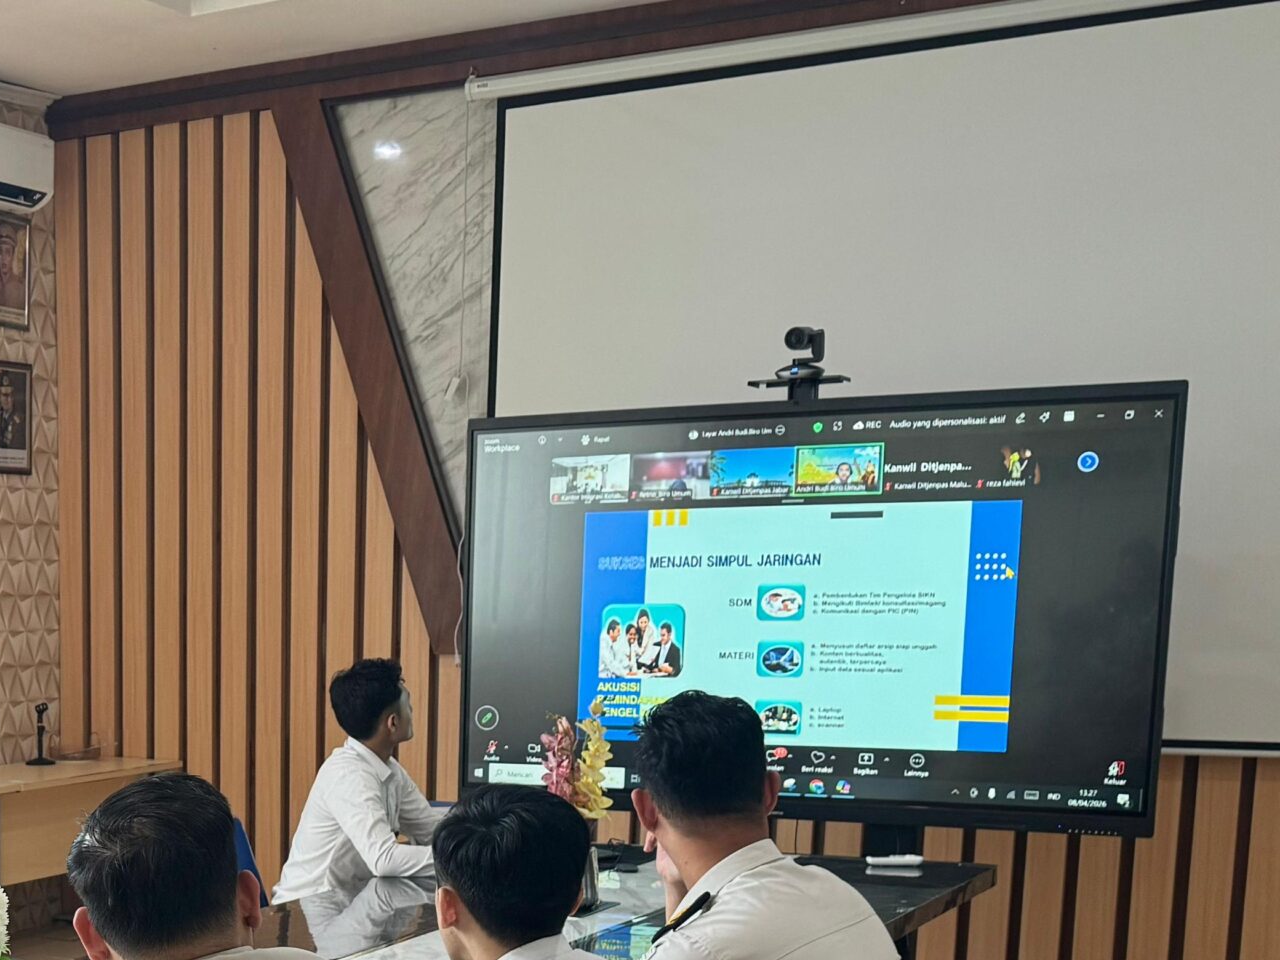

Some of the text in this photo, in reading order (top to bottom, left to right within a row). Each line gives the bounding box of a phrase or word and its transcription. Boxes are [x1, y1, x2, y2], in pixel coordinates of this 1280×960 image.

[865, 421, 882, 429] REC
[890, 420, 912, 428] Audio
[912, 419, 931, 429] yang
[989, 414, 1007, 424] aktif
[484, 444, 521, 453] Workplace
[884, 463, 917, 474] Kanwil
[649, 555, 702, 568] MENJADI
[707, 554, 753, 567] SIMPUL
[757, 553, 821, 567] JARINGAN
[728, 599, 753, 607] SDM
[719, 651, 755, 660] MATERI
[596, 682, 640, 692] AKUSISI
[904, 769, 929, 778] Lainnya
[1103, 777, 1127, 786] Keluar
